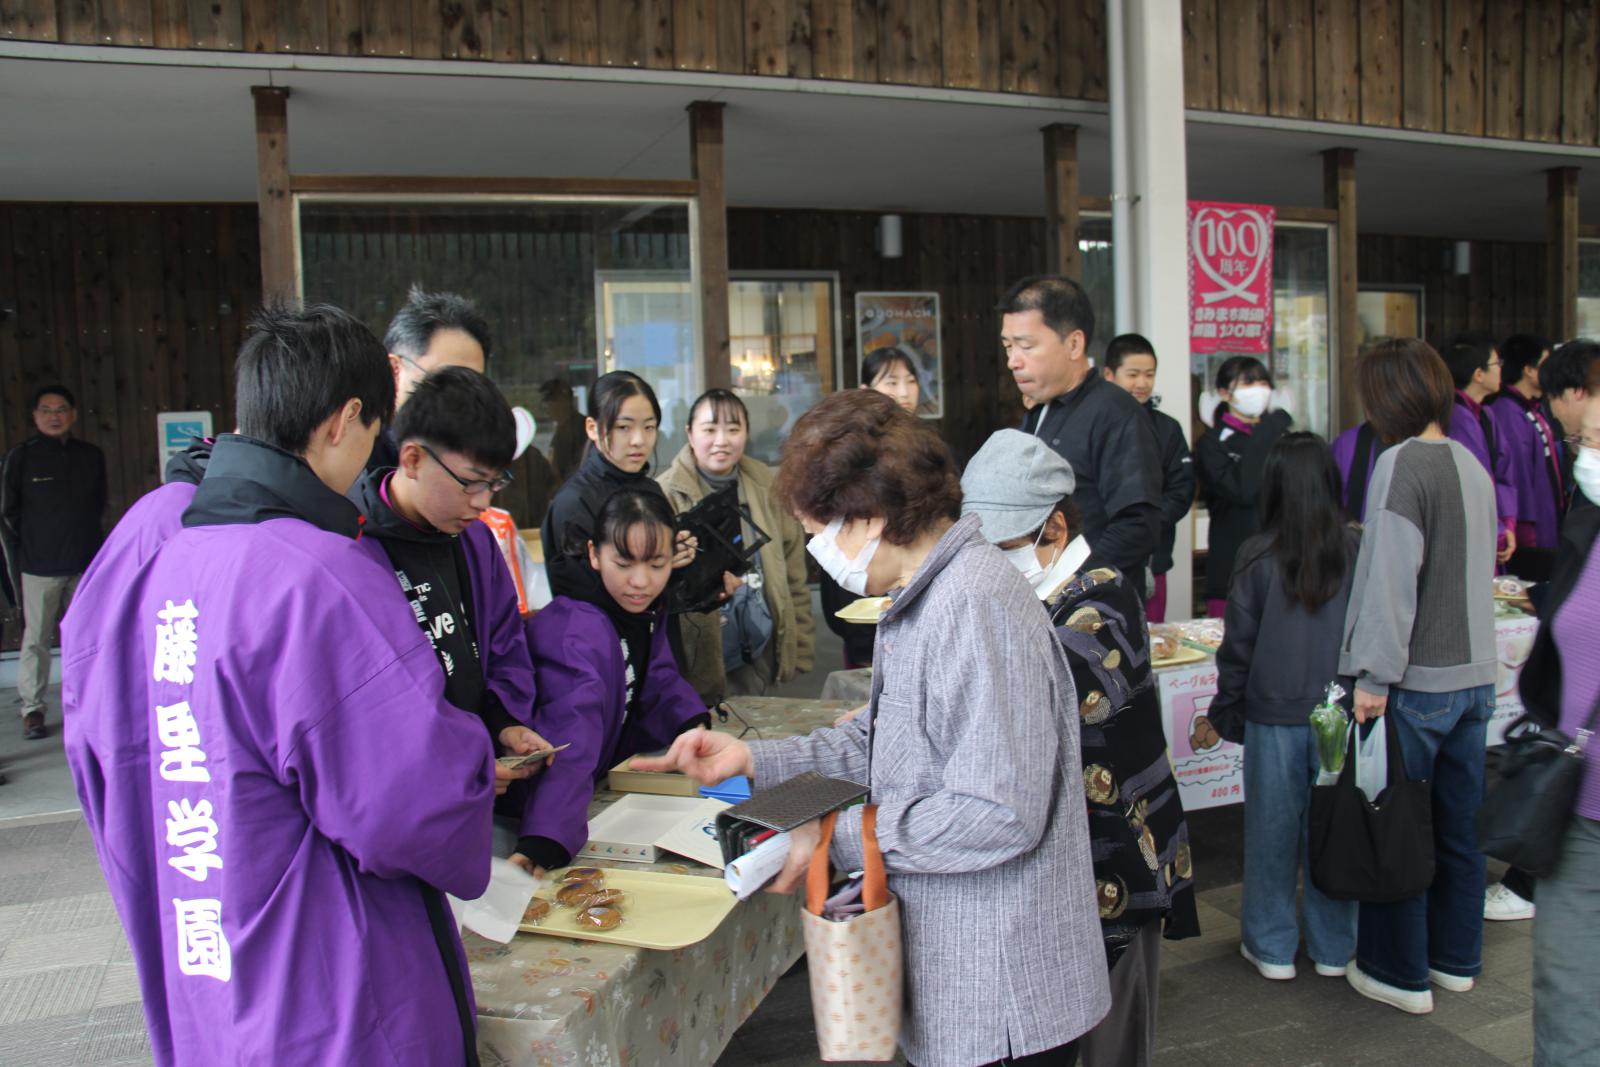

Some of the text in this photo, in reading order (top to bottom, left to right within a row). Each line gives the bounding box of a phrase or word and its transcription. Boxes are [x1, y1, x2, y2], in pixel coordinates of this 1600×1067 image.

[1200, 218, 1259, 257] 100
[1220, 258, 1249, 277] 周年
[153, 599, 232, 982] 藤里学園
